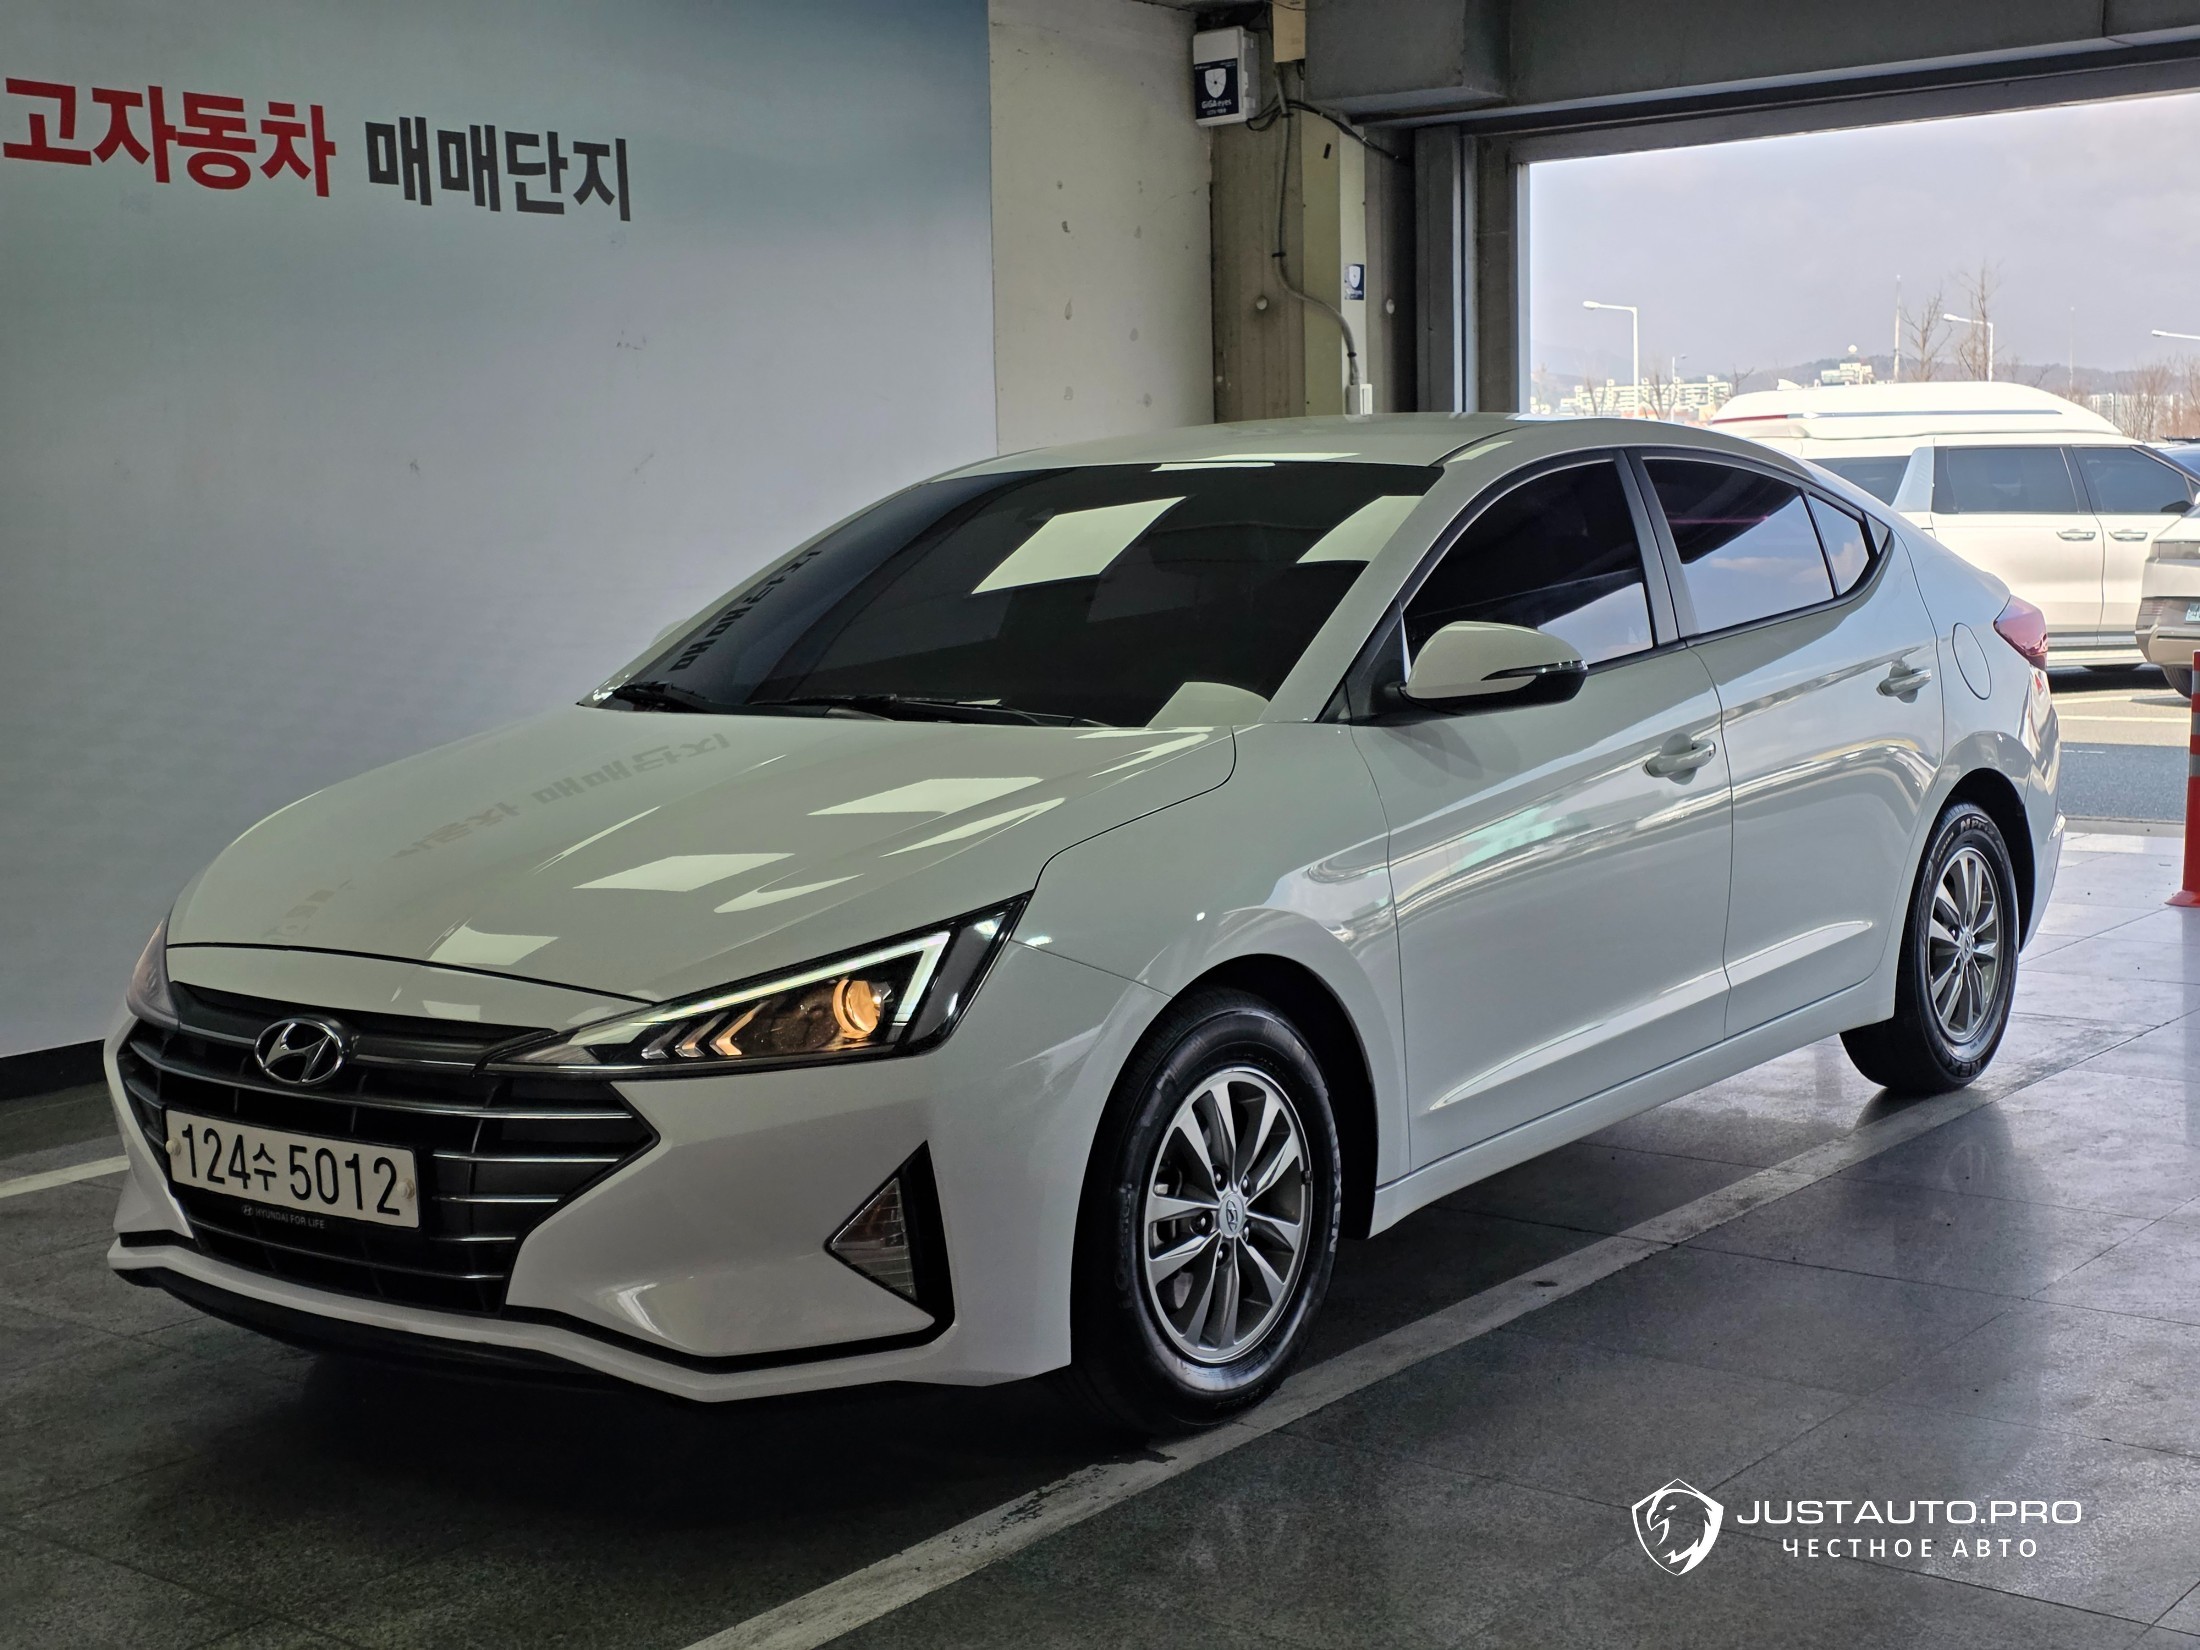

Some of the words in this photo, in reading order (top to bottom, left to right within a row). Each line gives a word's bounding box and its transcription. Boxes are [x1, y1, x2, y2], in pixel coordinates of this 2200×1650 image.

[3, 77, 336, 198] 고자동차
[365, 116, 631, 222] 매매단지
[255, 1208, 289, 1223] HYUNDAI
[290, 1214, 306, 1226] FOR
[307, 1218, 325, 1229] LIFE
